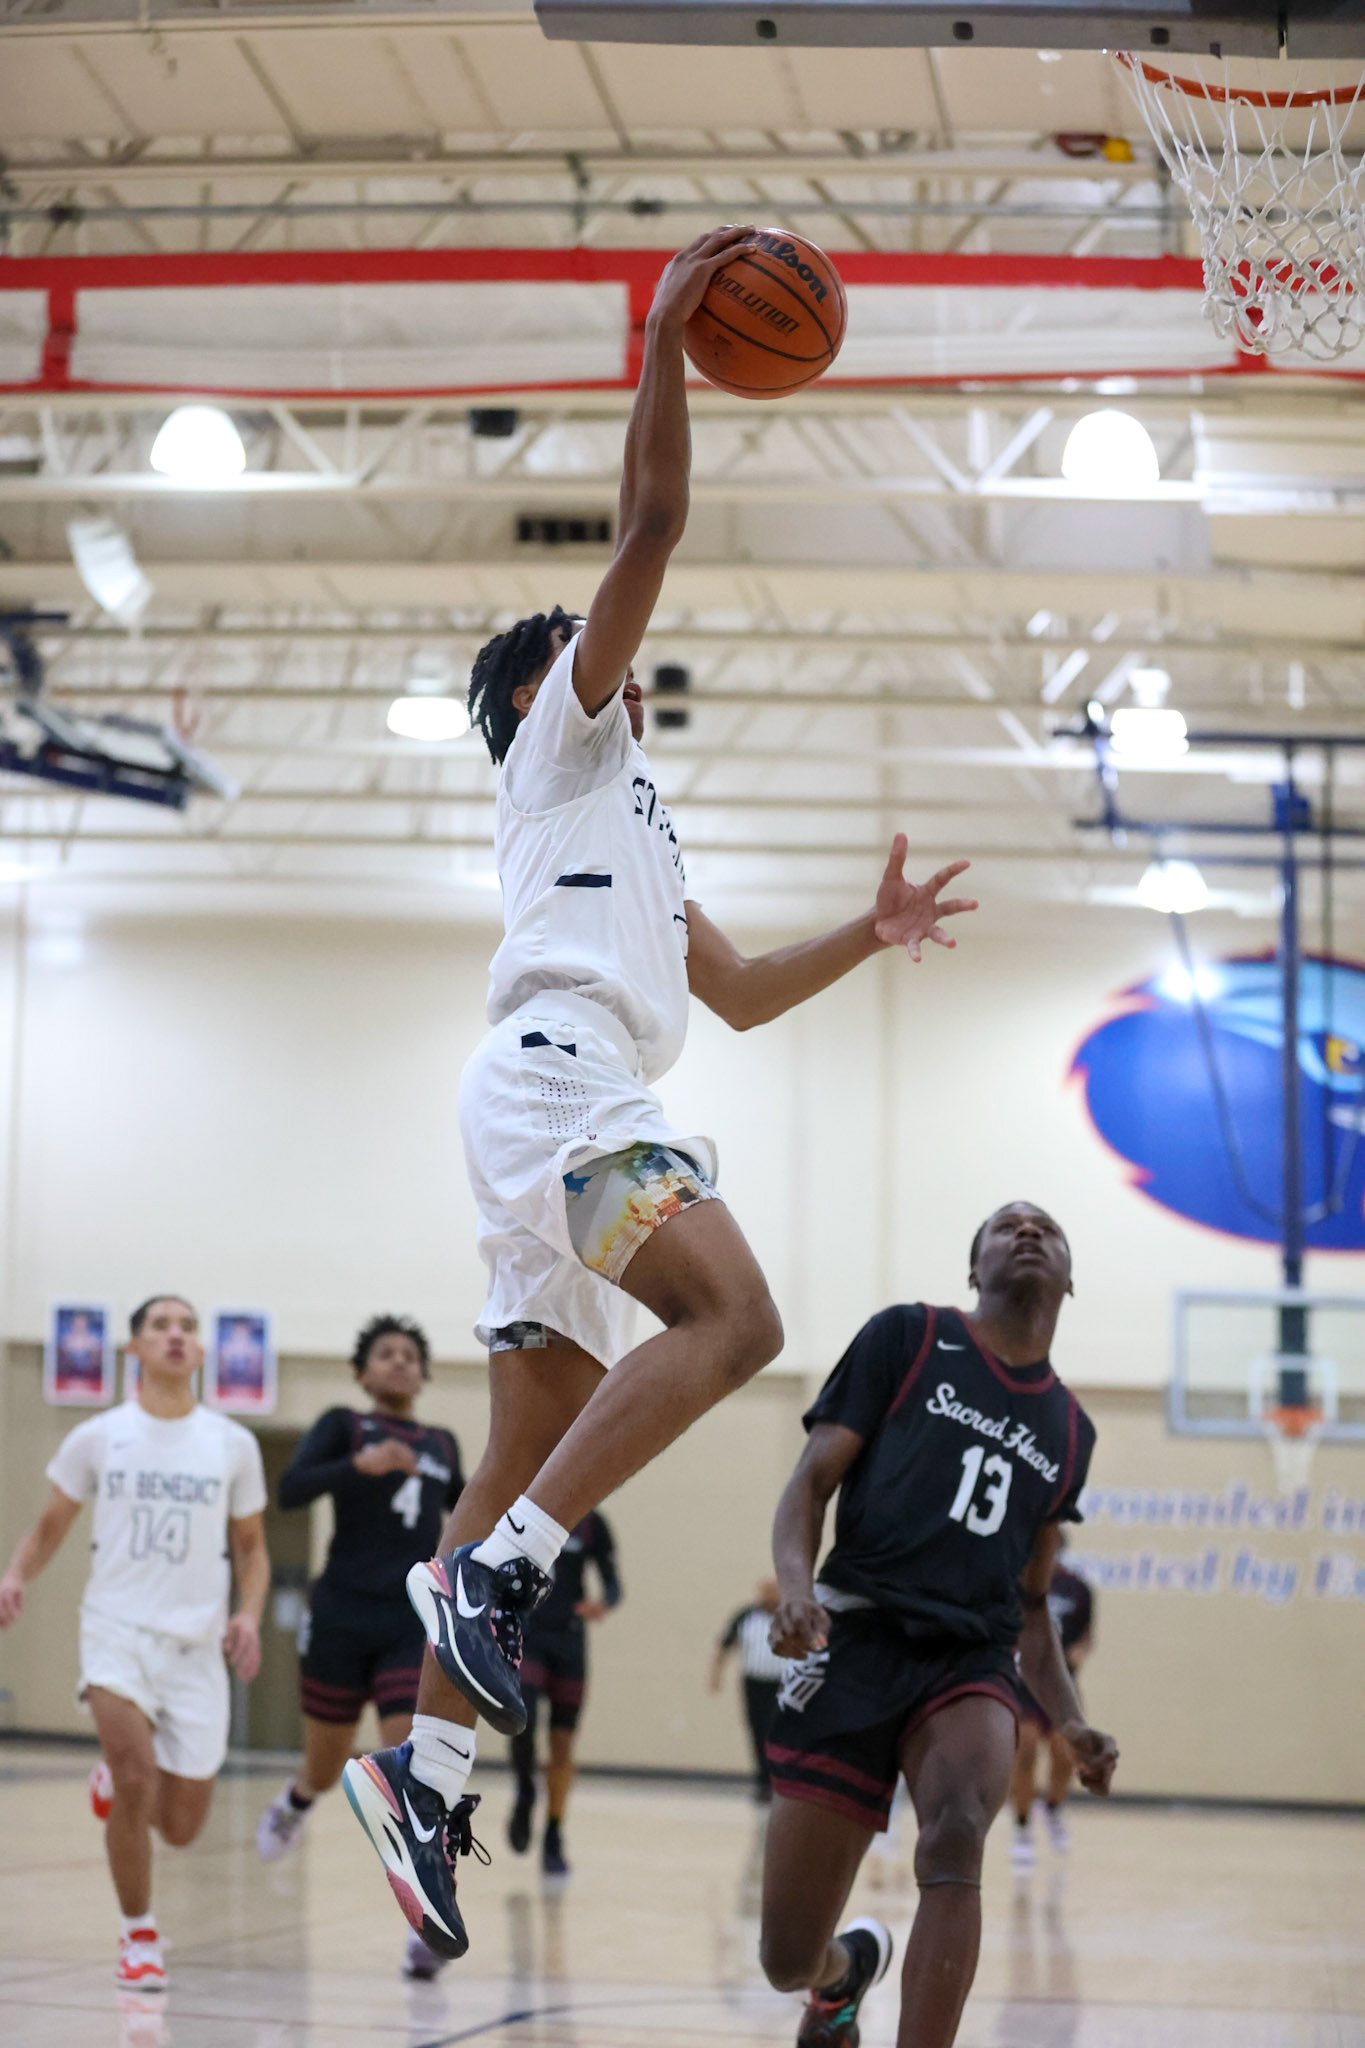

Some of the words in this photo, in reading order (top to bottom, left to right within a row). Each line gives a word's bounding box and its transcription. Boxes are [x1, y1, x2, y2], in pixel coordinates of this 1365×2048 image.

[712, 270, 800, 334] VOLUTION
[925, 1382, 1010, 1441] Sacred
[1002, 1422, 1061, 1484] Heart
[390, 1475, 424, 1530] 4
[948, 1444, 1013, 1537] 13
[1078, 1480, 1311, 1530] rounded
[129, 1503, 191, 1566] 14
